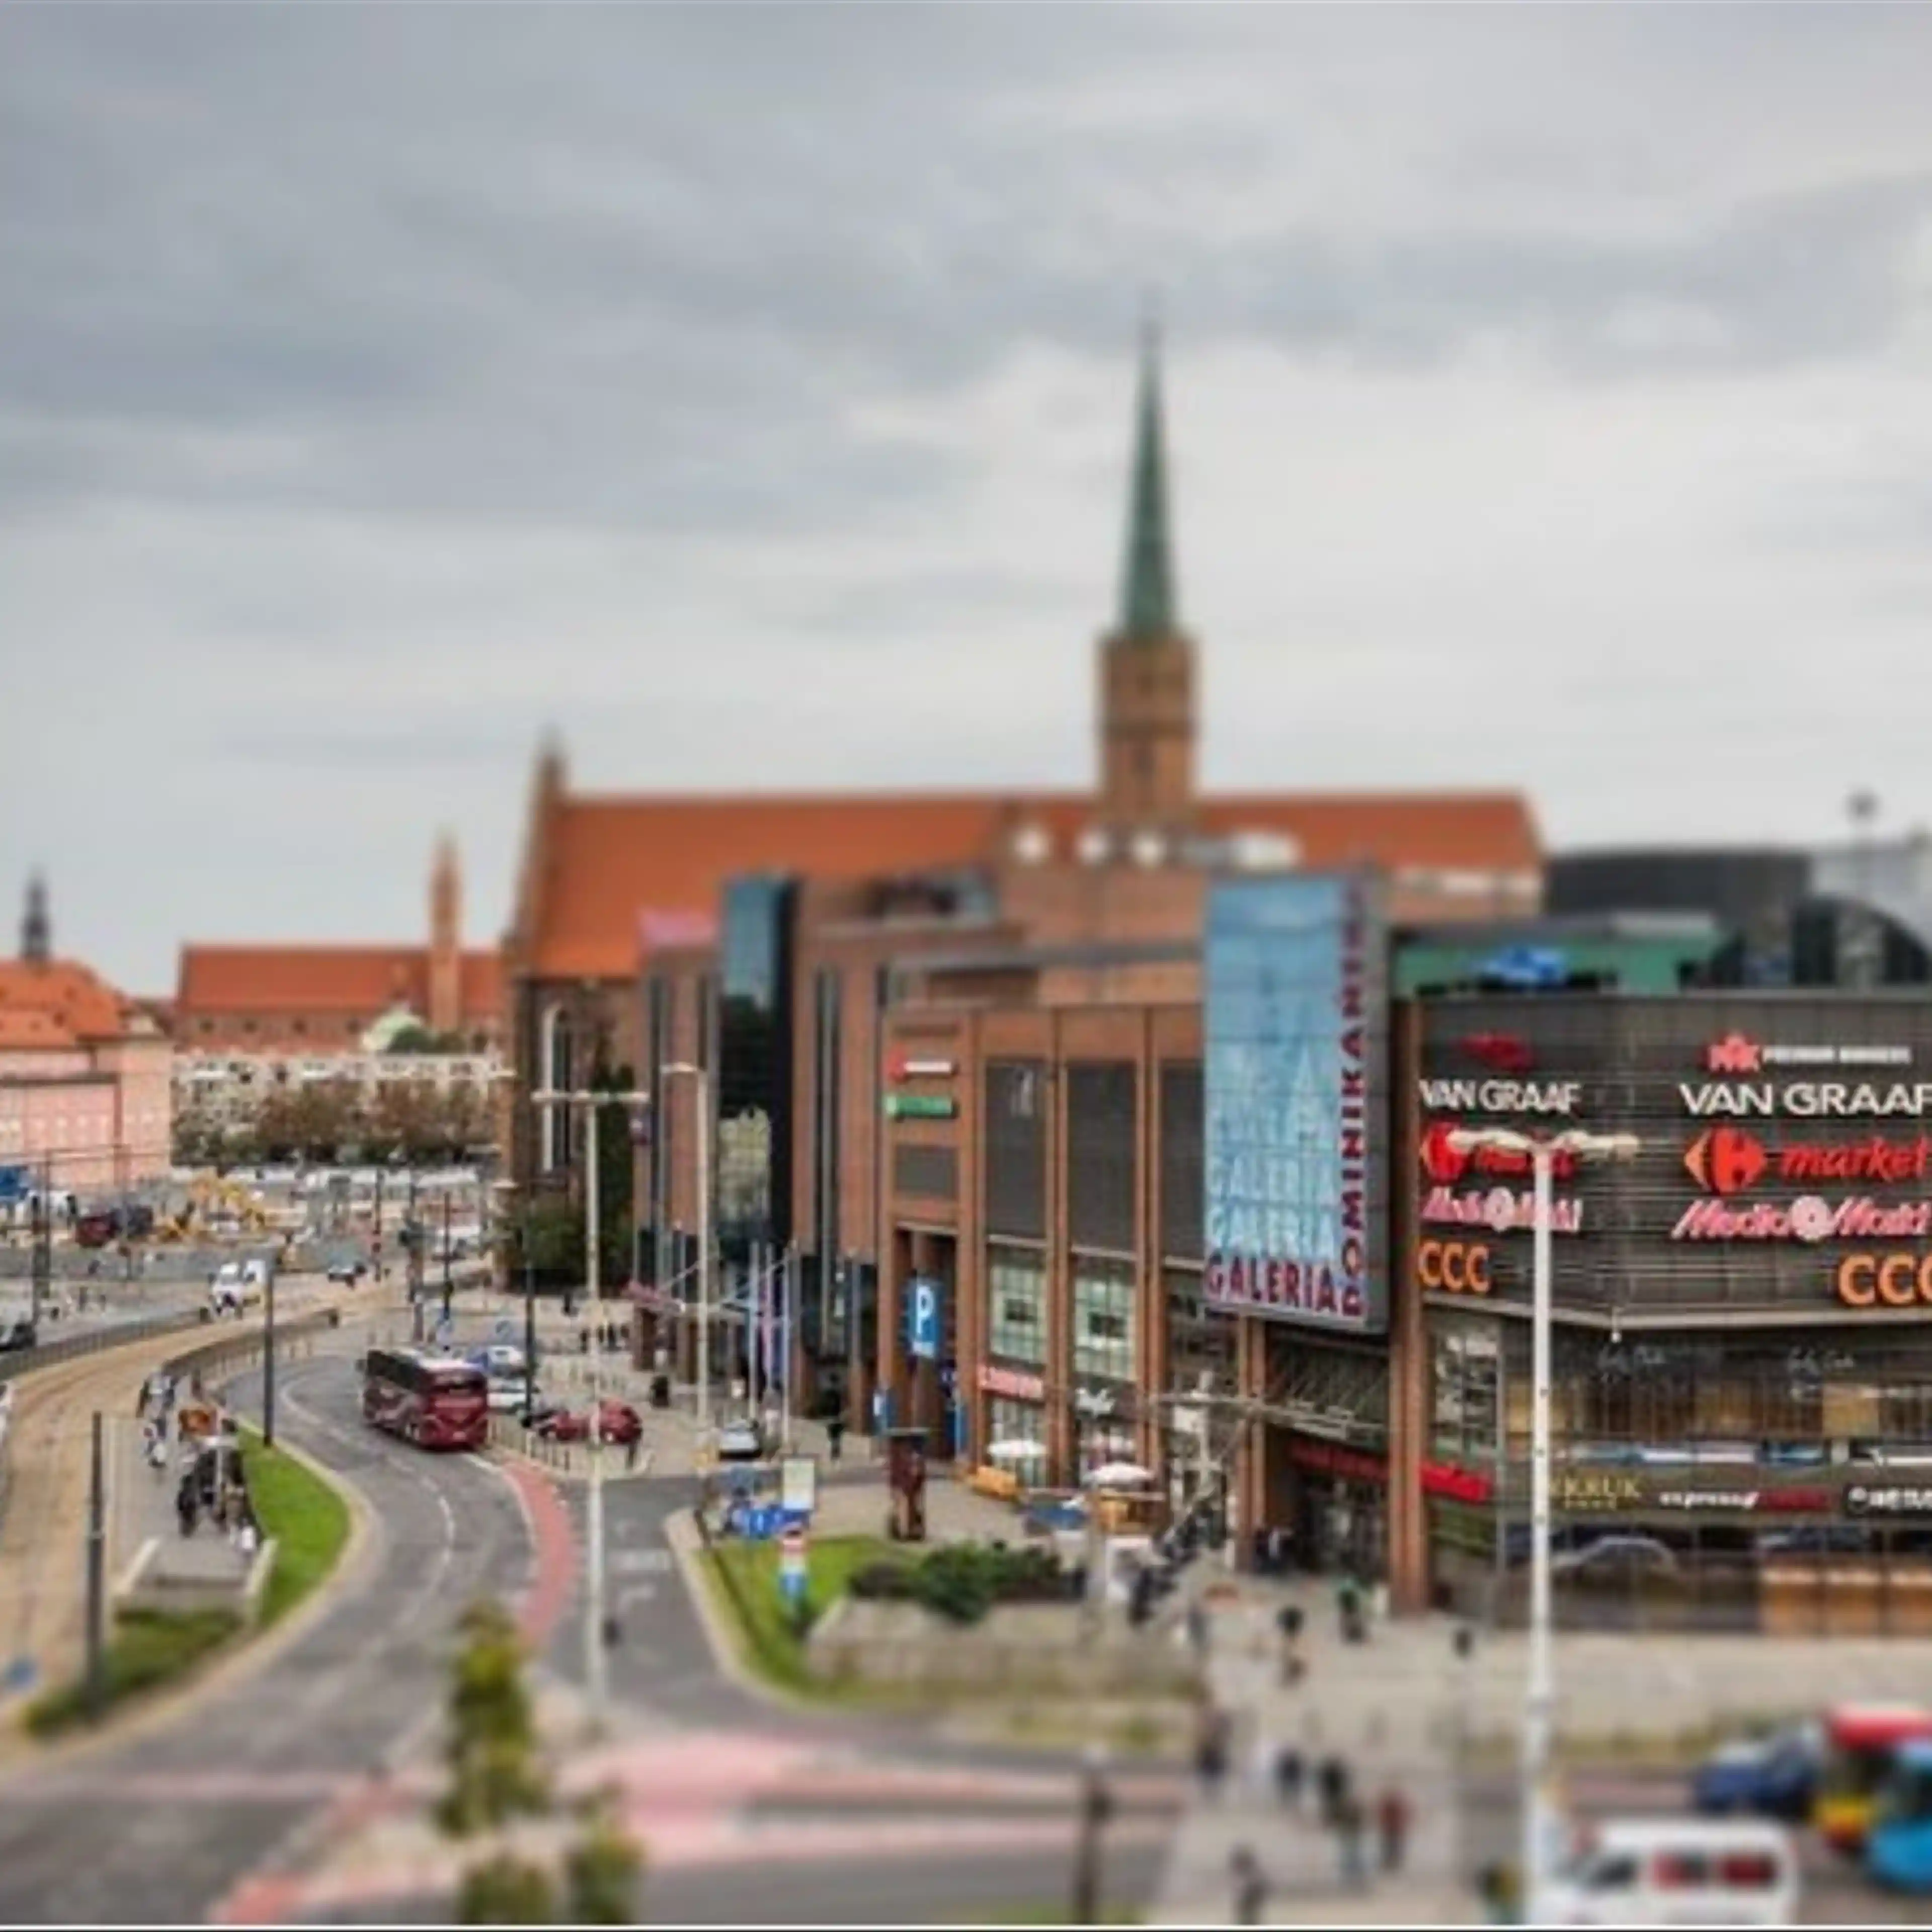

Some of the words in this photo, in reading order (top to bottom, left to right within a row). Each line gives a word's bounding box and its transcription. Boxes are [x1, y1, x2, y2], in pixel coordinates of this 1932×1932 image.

[1419, 1080, 1477, 1110] VAN
[1478, 1079, 1583, 1115] GRAAF
[1678, 1082, 1774, 1116] VAN
[1783, 1081, 1932, 1116] GRAAF
[1208, 1250, 1337, 1314] GALERIA
[1418, 1239, 1490, 1293] CCC
[915, 1285, 935, 1335] P
